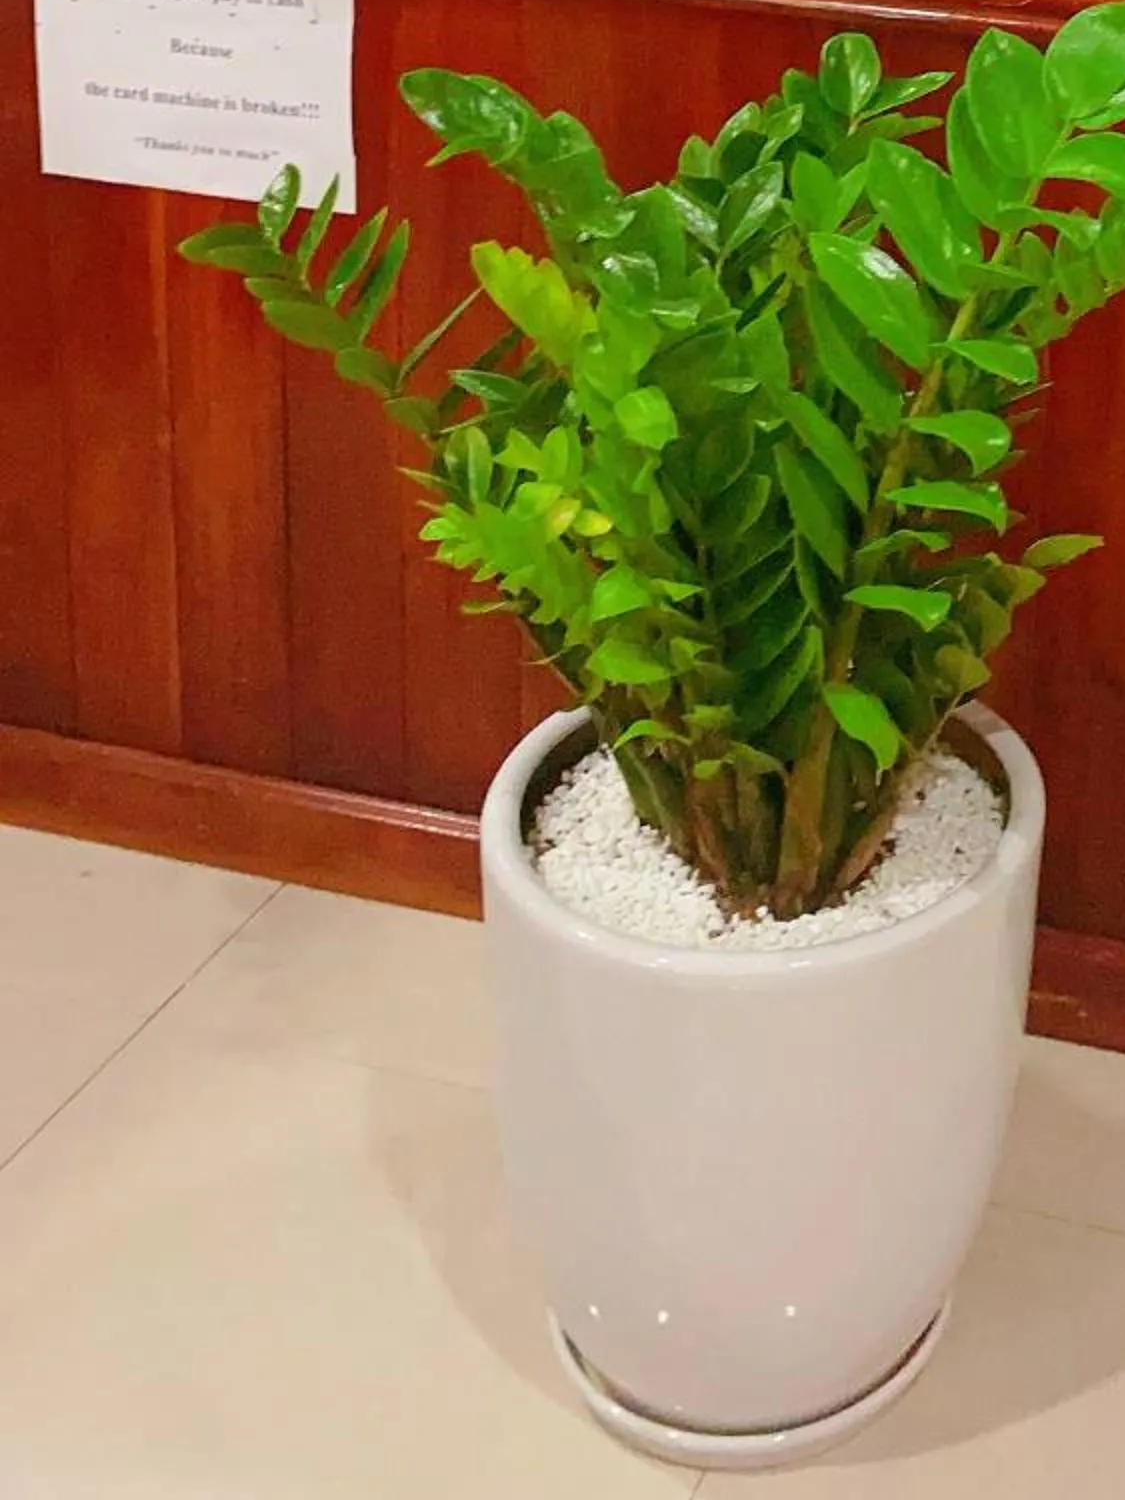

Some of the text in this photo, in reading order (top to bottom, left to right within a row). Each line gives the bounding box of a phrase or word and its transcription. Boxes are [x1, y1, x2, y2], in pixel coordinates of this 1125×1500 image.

[170, 37, 234, 58] Because
[84, 82, 320, 119] the card machine is broken!!!
[191, 145, 215, 156] you
